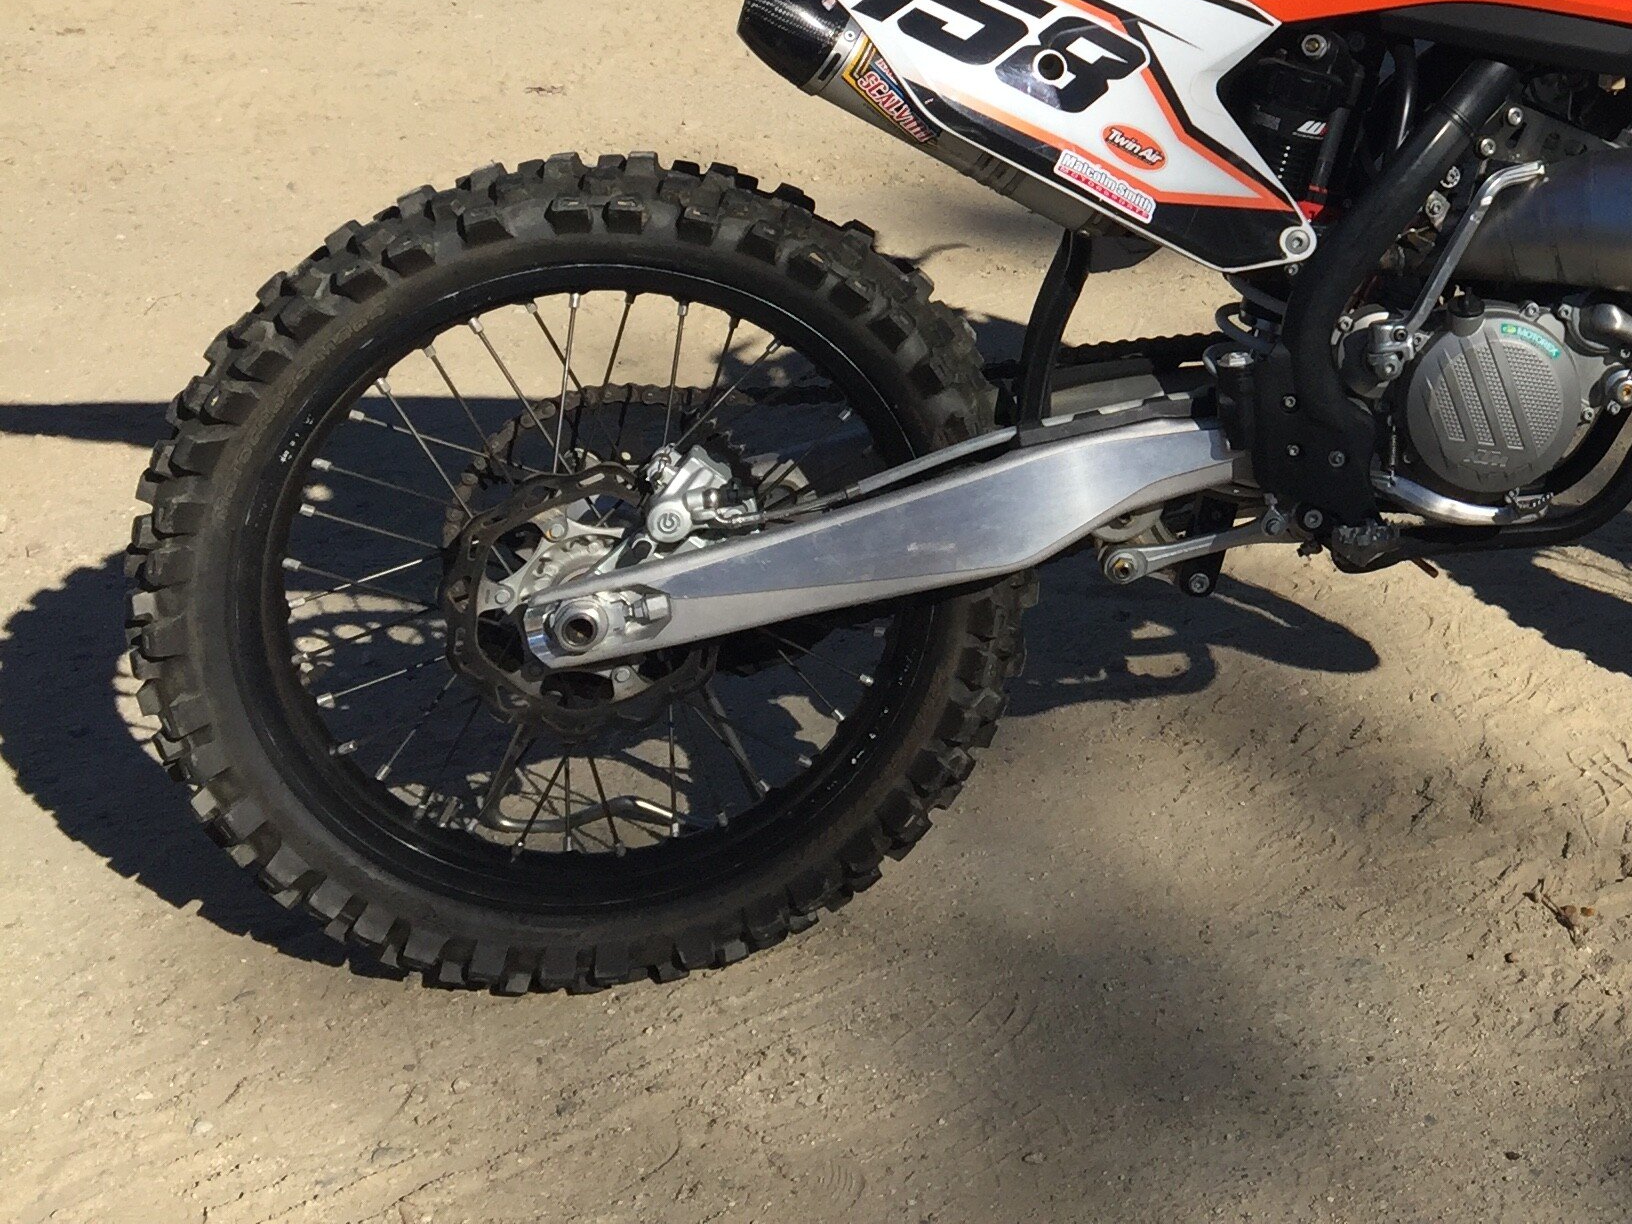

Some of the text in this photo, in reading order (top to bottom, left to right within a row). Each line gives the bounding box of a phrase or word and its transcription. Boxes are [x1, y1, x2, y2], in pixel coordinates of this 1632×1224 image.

[1107, 127, 1141, 154] Twin
[1137, 146, 1165, 165] Air
[1061, 152, 1118, 193] Malcolm
[1115, 180, 1153, 214] Smith
[1516, 325, 1559, 357] MOTOREX
